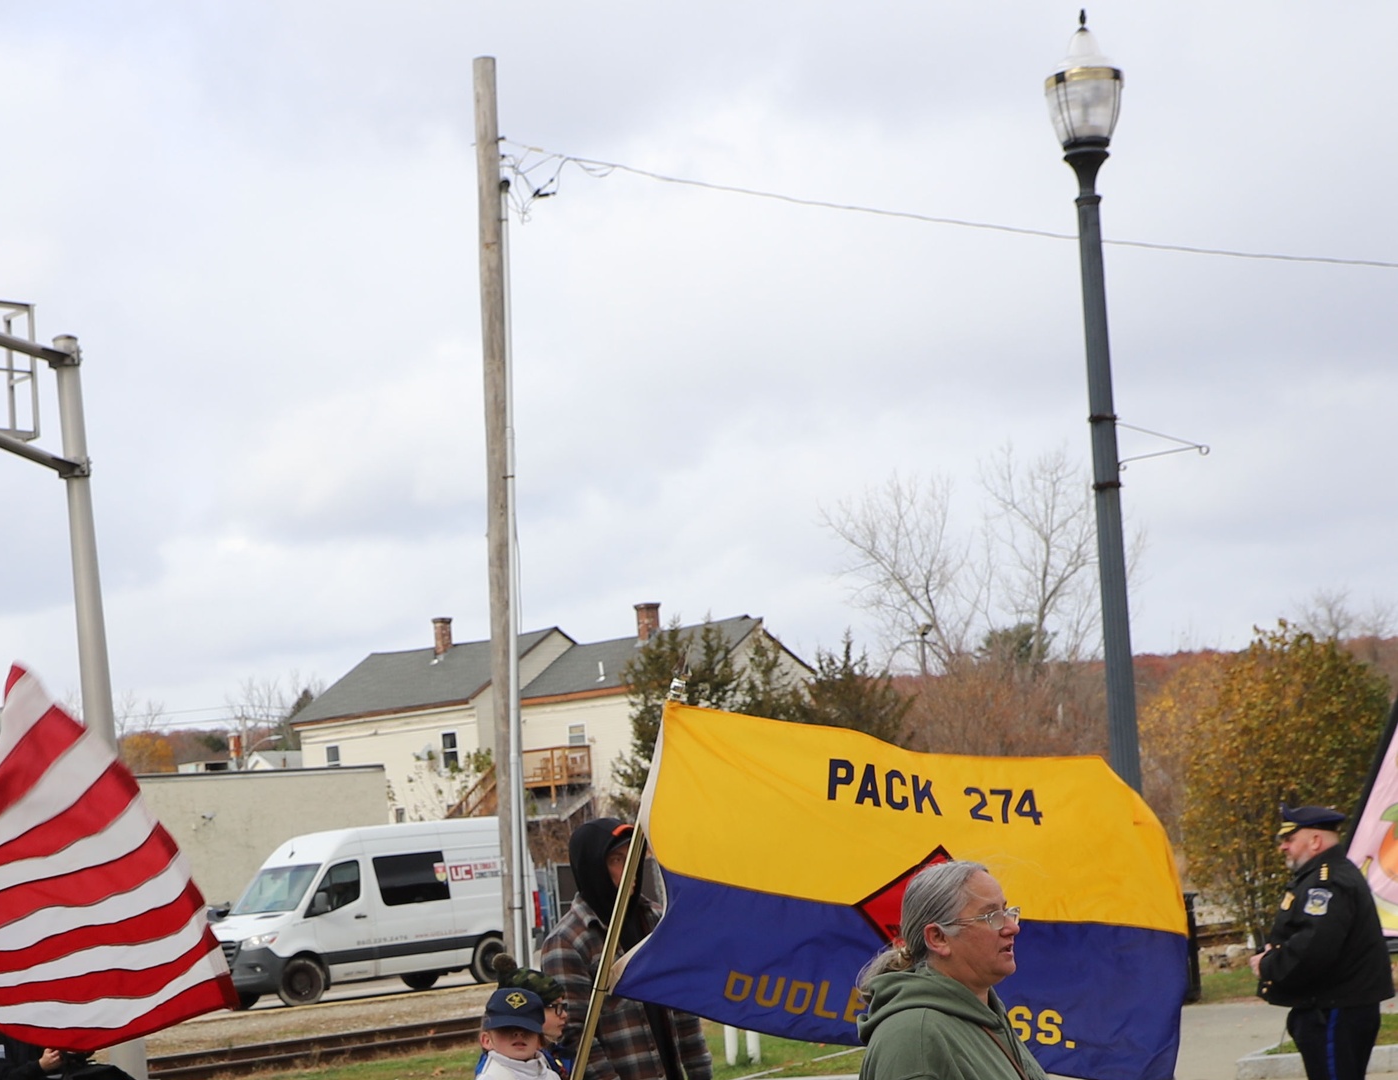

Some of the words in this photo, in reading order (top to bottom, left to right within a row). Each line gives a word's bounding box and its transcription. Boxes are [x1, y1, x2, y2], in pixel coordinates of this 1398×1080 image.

[827, 758, 943, 816] PACK
[963, 786, 1043, 826] 274
[451, 865, 472, 880] UC
[722, 969, 869, 1024] DUDLE
